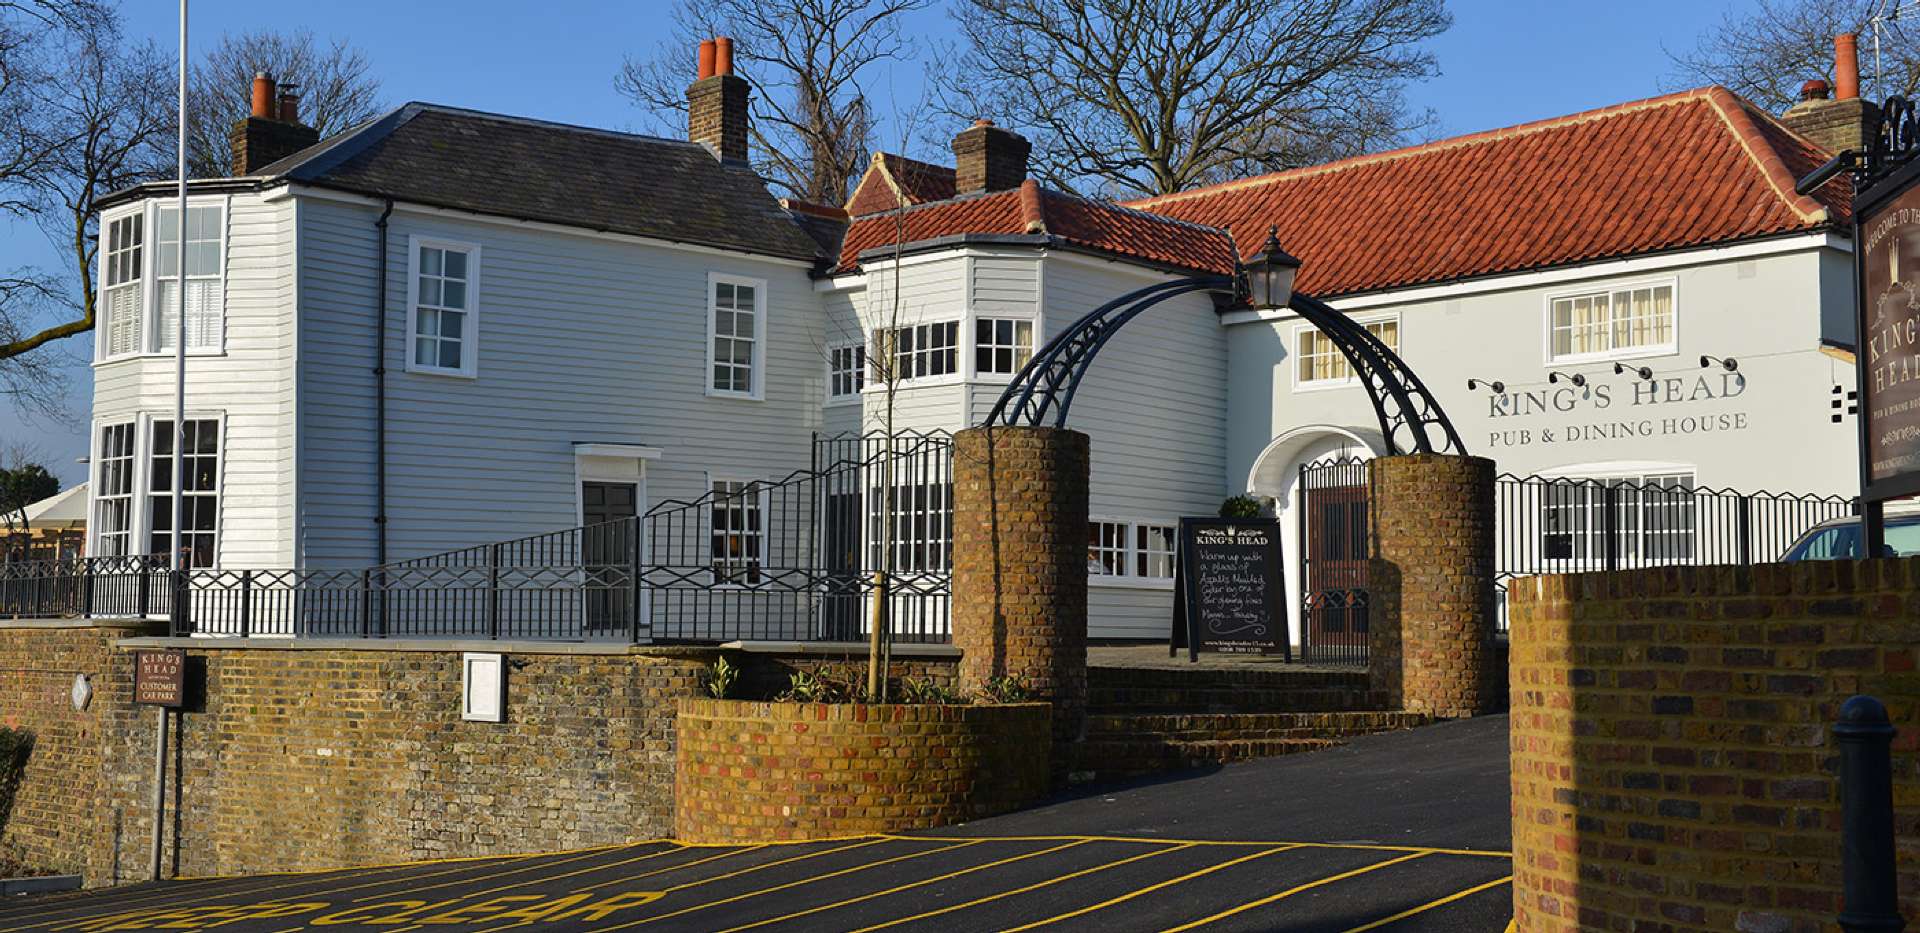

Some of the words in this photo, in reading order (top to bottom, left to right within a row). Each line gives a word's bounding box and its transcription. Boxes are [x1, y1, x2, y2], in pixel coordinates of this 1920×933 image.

[1864, 212, 1897, 256] WELCOME
[1899, 208, 1909, 225] TO
[1911, 208, 1920, 225] TH
[1870, 315, 1920, 364] KING'
[1488, 383, 1612, 419] KING'S
[1631, 372, 1747, 407] HEAD
[1489, 430, 1532, 447] PUB
[1541, 428, 1556, 443] &
[1566, 420, 1653, 442] DINING
[1662, 413, 1748, 435] HOUSE
[1196, 536, 1234, 545] KING'S
[1237, 536, 1269, 545] HEAD
[1199, 548, 1225, 560] Warm
[1227, 553, 1239, 564] up
[1242, 551, 1263, 561] with
[1200, 563, 1208, 571] a
[1212, 562, 1237, 574] glass
[142, 654, 180, 665] KING'S
[144, 665, 177, 674] HEAD
[140, 682, 177, 691] CUSTOMER
[142, 692, 155, 700] CAR
[156, 692, 175, 700] PARK
[309, 891, 667, 926] CLEAR
